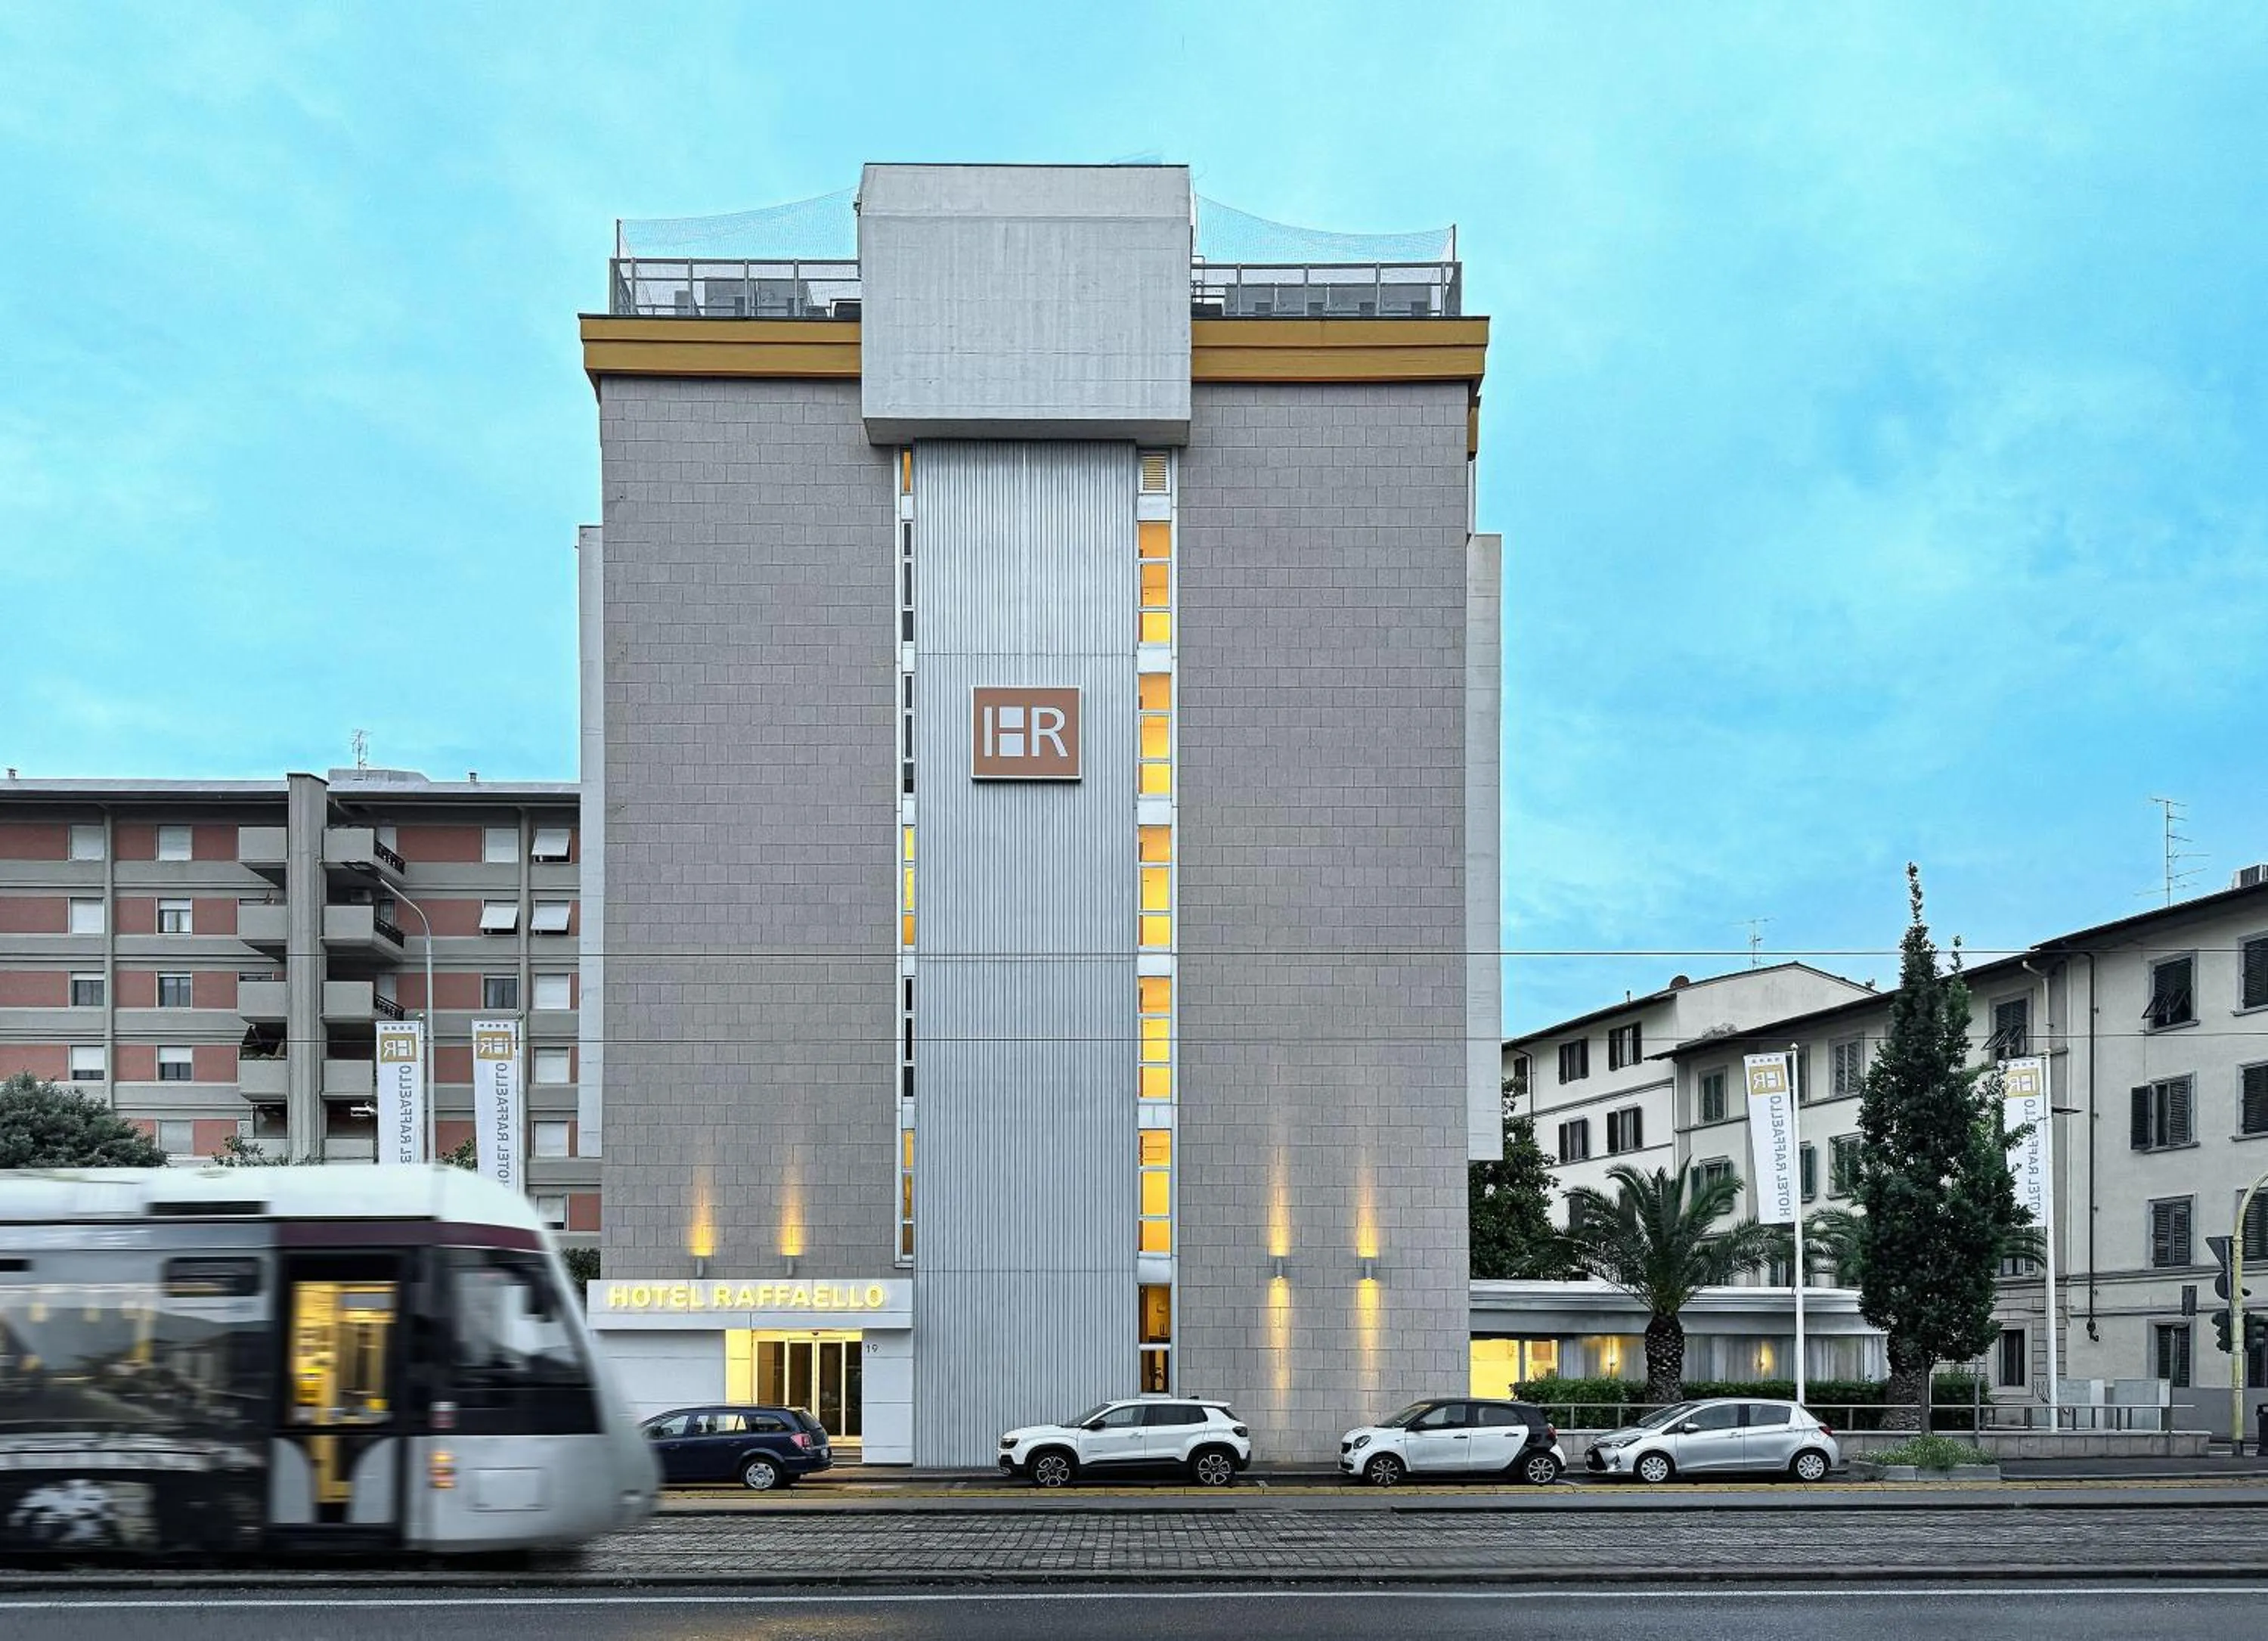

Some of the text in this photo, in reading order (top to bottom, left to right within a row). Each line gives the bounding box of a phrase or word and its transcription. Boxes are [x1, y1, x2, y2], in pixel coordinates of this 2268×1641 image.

[984, 706, 1068, 757] HR
[608, 1283, 885, 1308] HOTEL RAFFAELLO
[866, 1343, 878, 1354] 19
